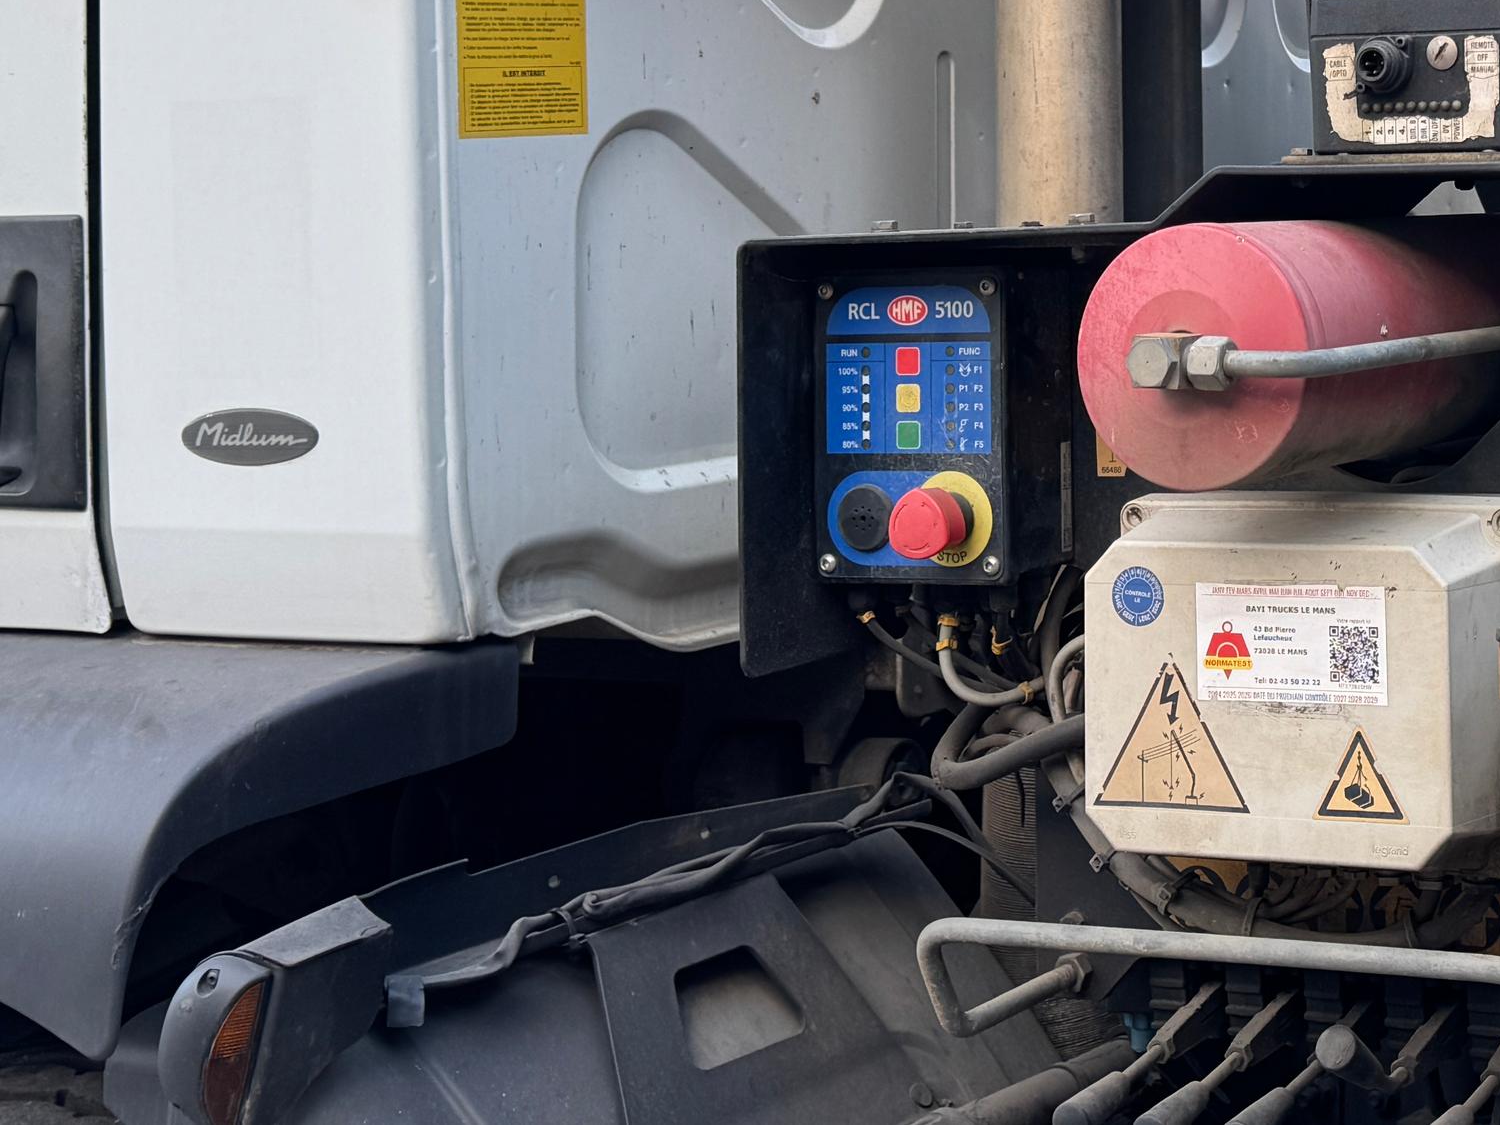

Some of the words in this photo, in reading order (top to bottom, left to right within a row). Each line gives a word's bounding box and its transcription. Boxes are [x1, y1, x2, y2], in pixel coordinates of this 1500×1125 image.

[1470, 41, 1494, 49] REMOTE
[1329, 59, 1347, 68] CABLE
[1329, 70, 1347, 78] /OPTO
[1365, 126, 1372, 135] 1.
[1376, 126, 1383, 135] 2.
[1388, 126, 1394, 135] 3.
[1399, 125, 1405, 135] 4.
[848, 303, 880, 320] RCL
[892, 299, 922, 321] HMF
[936, 301, 973, 319] 5100
[840, 349, 858, 357] RUN
[838, 367, 858, 375] 100%
[974, 366, 983, 374] F1
[842, 386, 858, 394] 95%
[959, 385, 968, 393] P1
[974, 385, 984, 393] F2
[842, 404, 858, 412] 90%
[959, 403, 969, 411] P2
[974, 403, 984, 411] F3
[842, 423, 858, 431] 85%
[974, 422, 984, 430] F4
[195, 421, 308, 447] Midlum
[842, 441, 859, 449] 80%
[937, 551, 967, 563] STOP
[1205, 659, 1252, 667] NORMATEST
[1276, 693, 1303, 701] PROCHAIN
[1305, 692, 1331, 702] CONTRÔLE
